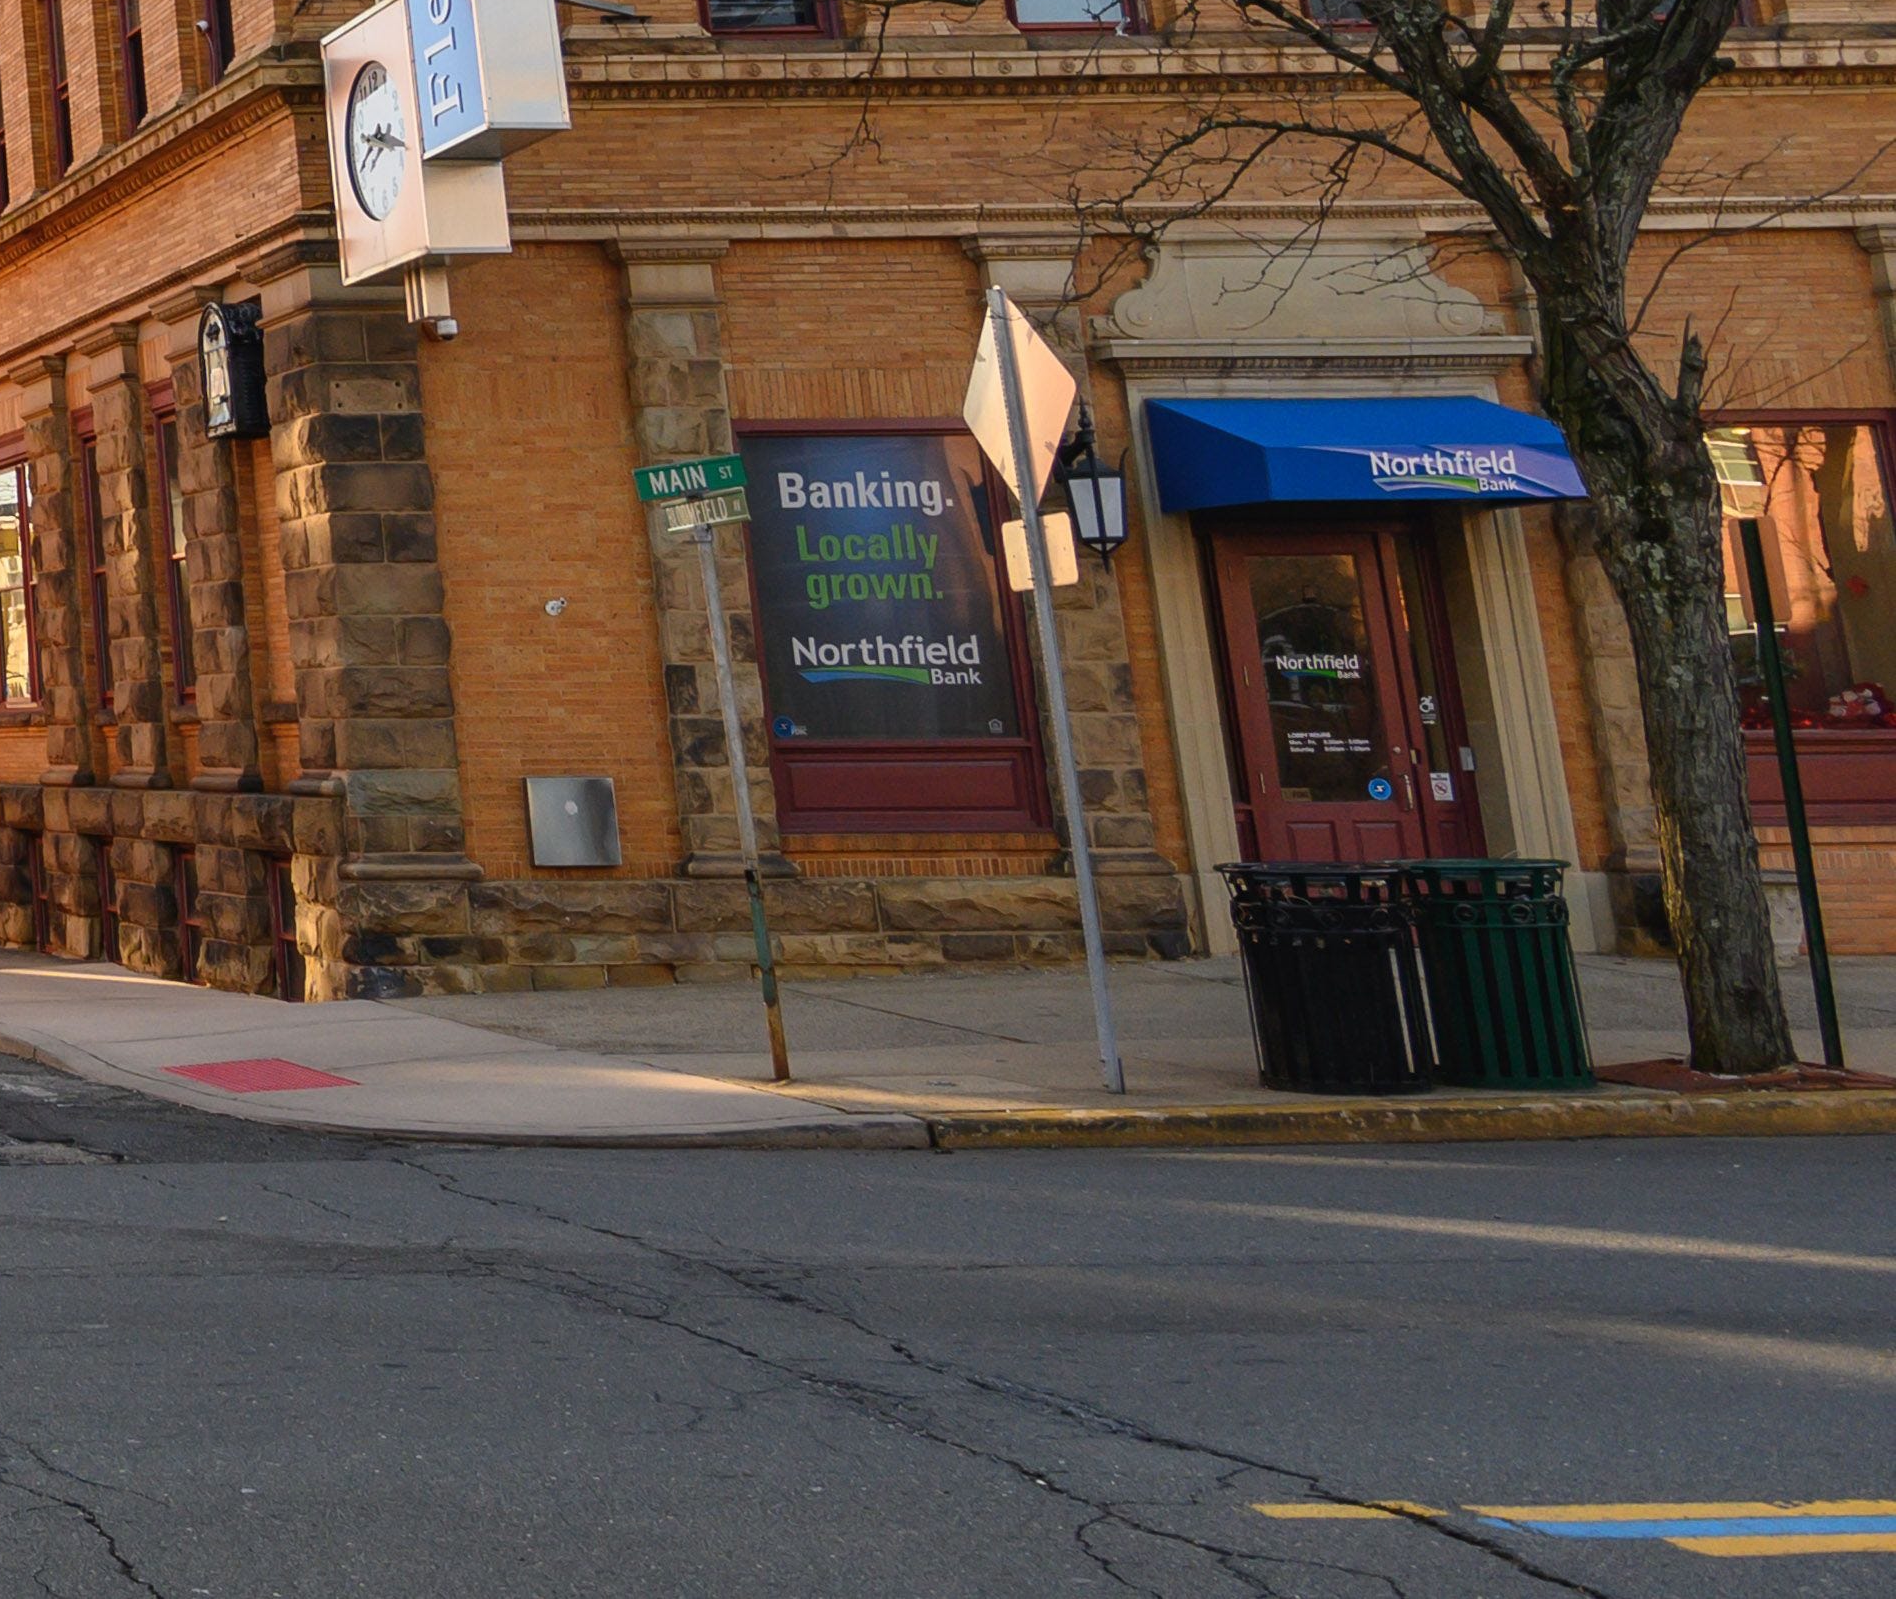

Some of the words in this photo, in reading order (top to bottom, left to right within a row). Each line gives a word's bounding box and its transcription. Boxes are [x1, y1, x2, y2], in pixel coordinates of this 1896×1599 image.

[368, 71, 378, 94] 12
[1369, 450, 1517, 476] Northfield
[649, 465, 707, 495] MAIN
[718, 466, 733, 479] ST
[1478, 478, 1518, 491] Bank
[777, 471, 954, 516] Banking.
[796, 524, 938, 569] Locally
[806, 572, 944, 610] grown.
[791, 635, 981, 666] Northfield
[1275, 654, 1360, 670] Northfield
[930, 668, 983, 685] Bank
[1337, 670, 1361, 679] Bank
